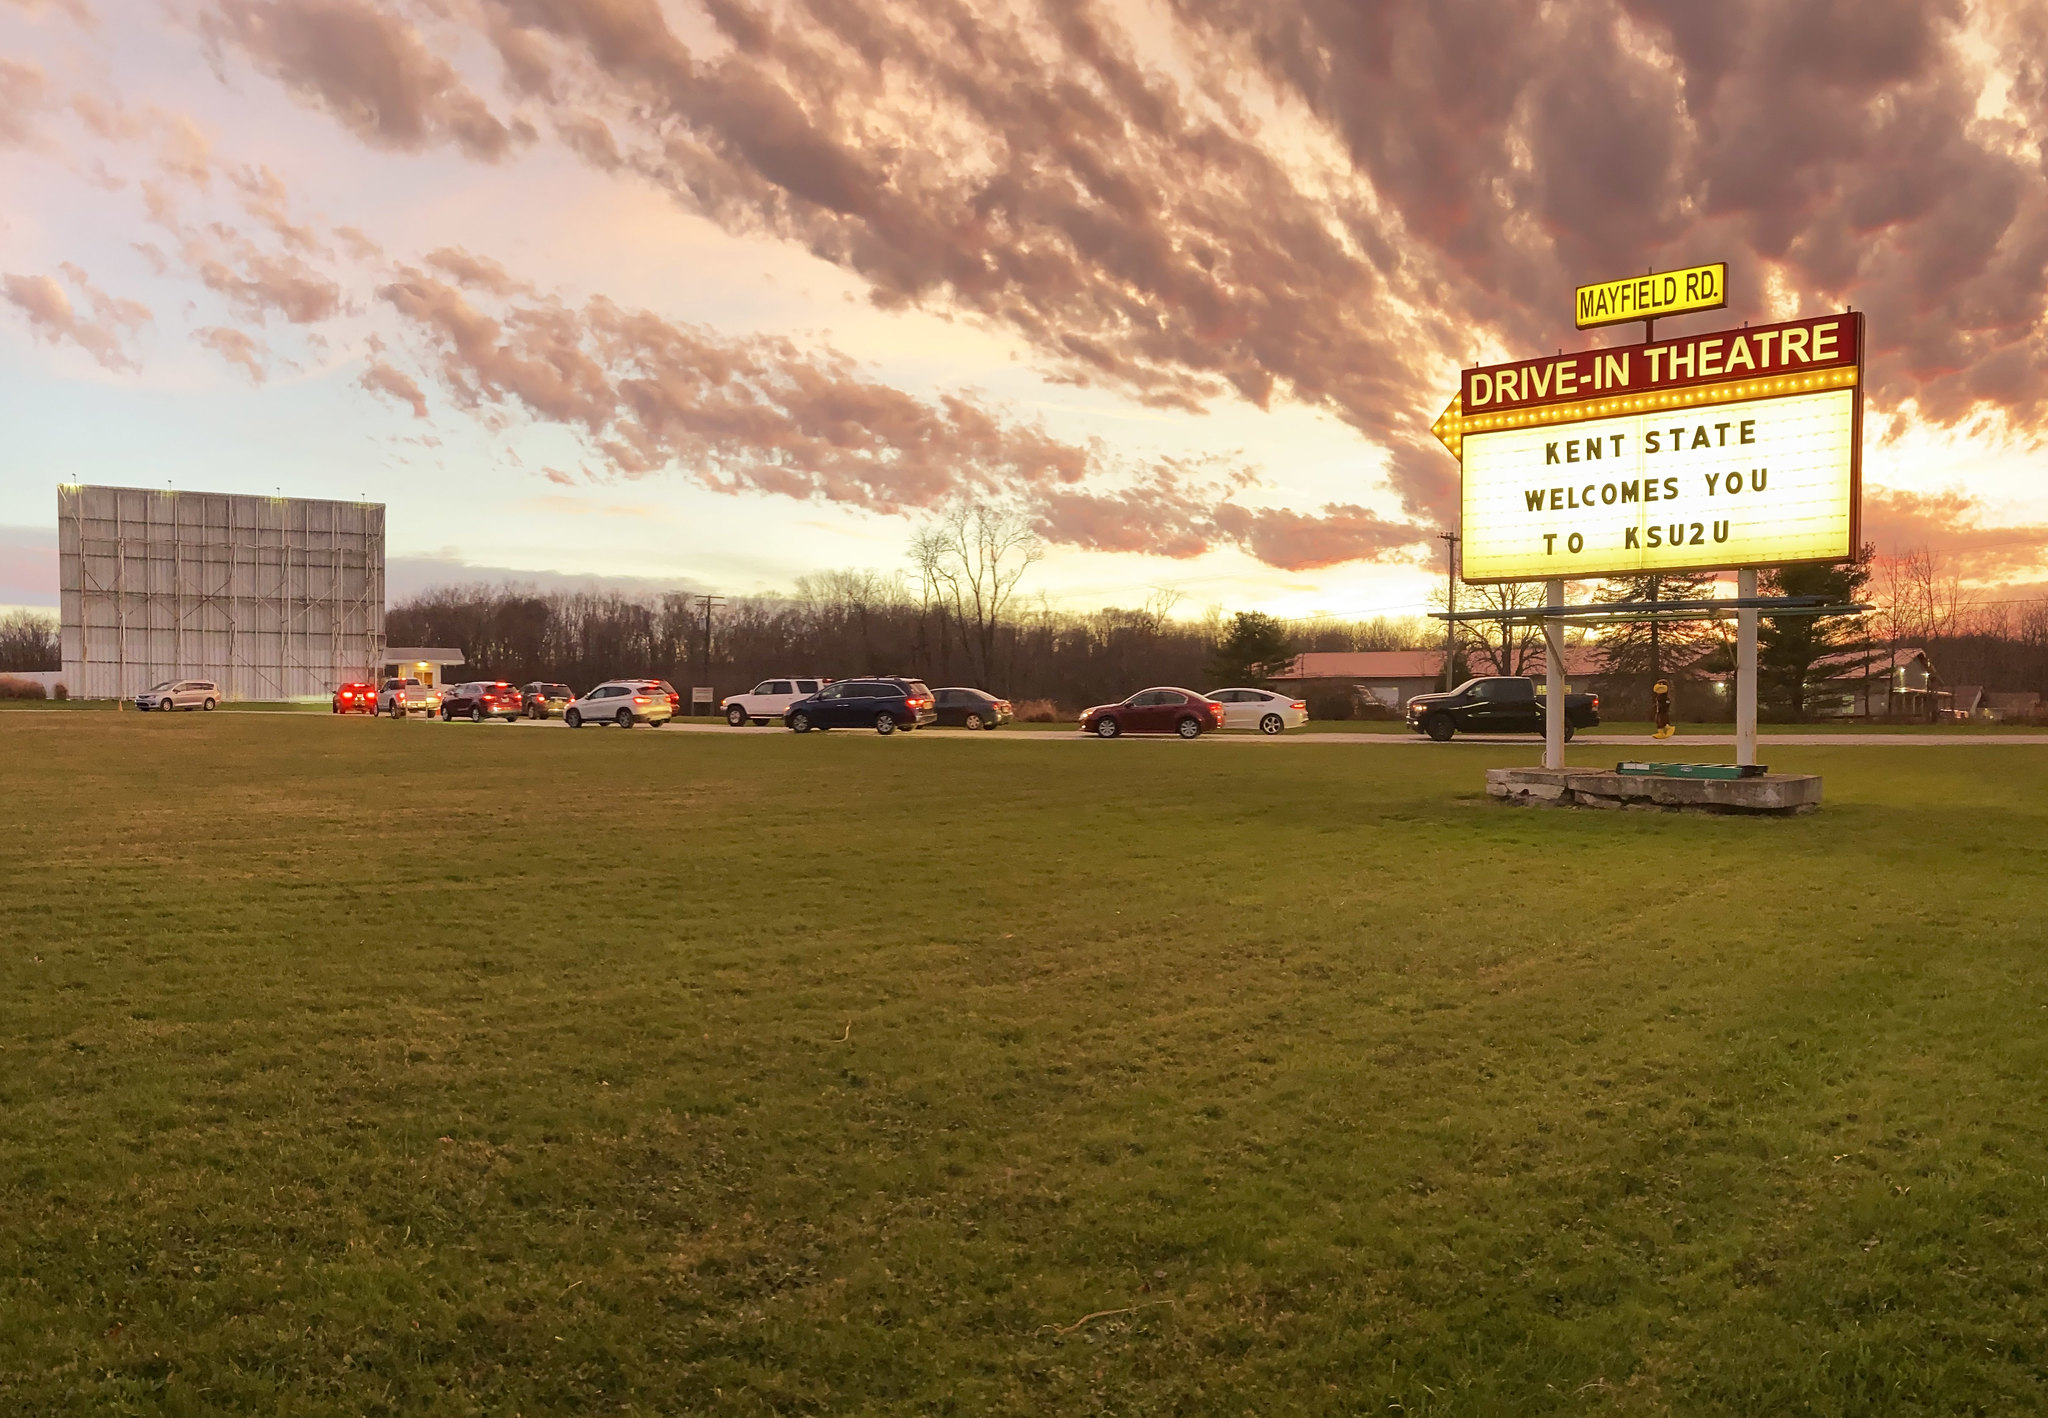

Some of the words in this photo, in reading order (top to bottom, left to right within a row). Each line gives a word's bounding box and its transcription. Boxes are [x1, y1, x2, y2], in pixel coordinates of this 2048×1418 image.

[1579, 277, 1677, 320] MAYFIELD
[1685, 269, 1719, 302] RD.
[1470, 352, 1630, 407] DRIVE-IN
[1644, 322, 1840, 383] THEATRE
[1545, 434, 1625, 465] KENT
[1645, 420, 1756, 454] STATE
[1525, 477, 1679, 512] WELCOMES
[1705, 468, 1768, 496] YOU
[1543, 532, 1584, 556] TO
[1625, 520, 1730, 549] KSU2U
